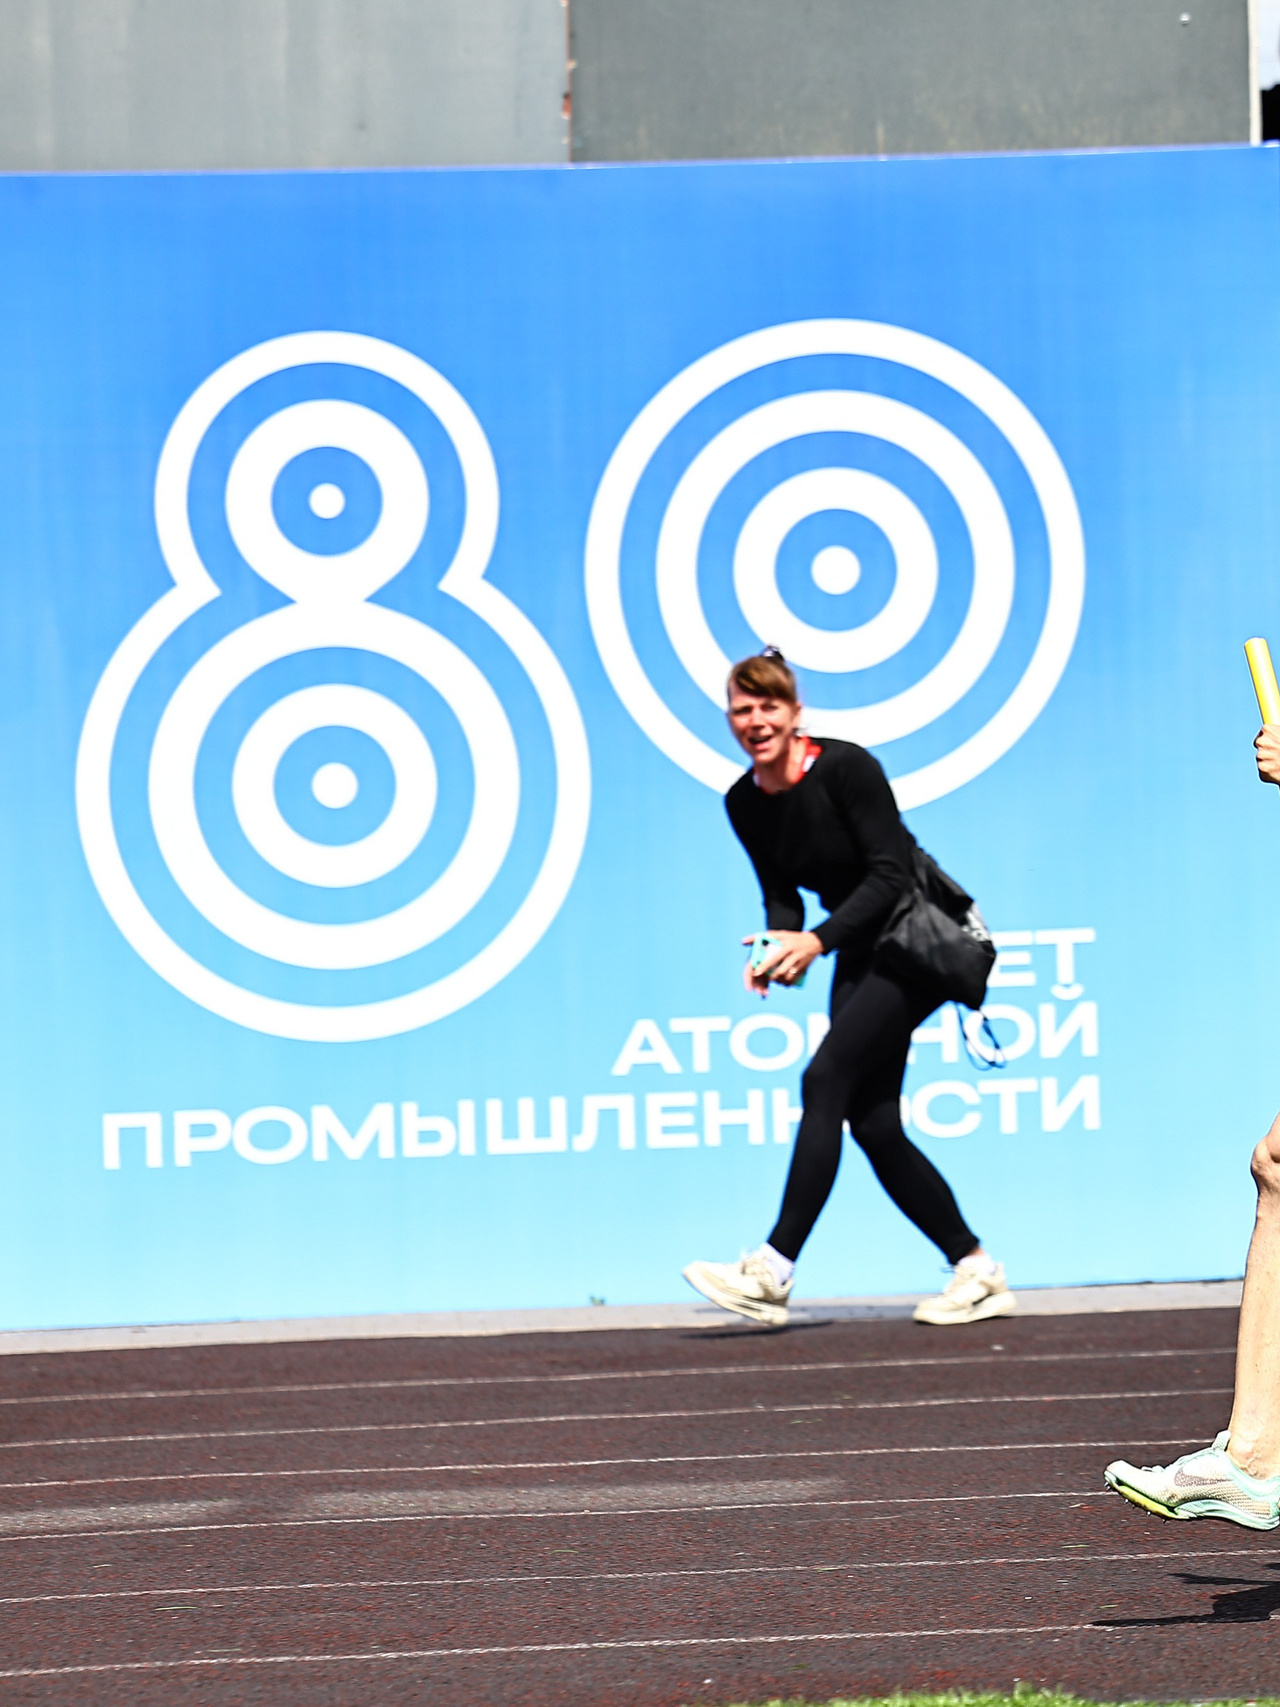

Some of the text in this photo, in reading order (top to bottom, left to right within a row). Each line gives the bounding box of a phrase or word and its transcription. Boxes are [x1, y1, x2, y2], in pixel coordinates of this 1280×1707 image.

[76, 320, 1085, 1042] 80
[986, 927, 1096, 988] ЕТ
[612, 983, 1099, 1076] АТОНОЙ
[102, 1074, 1101, 1170] ПРОМЫШЛЕННСТИ
